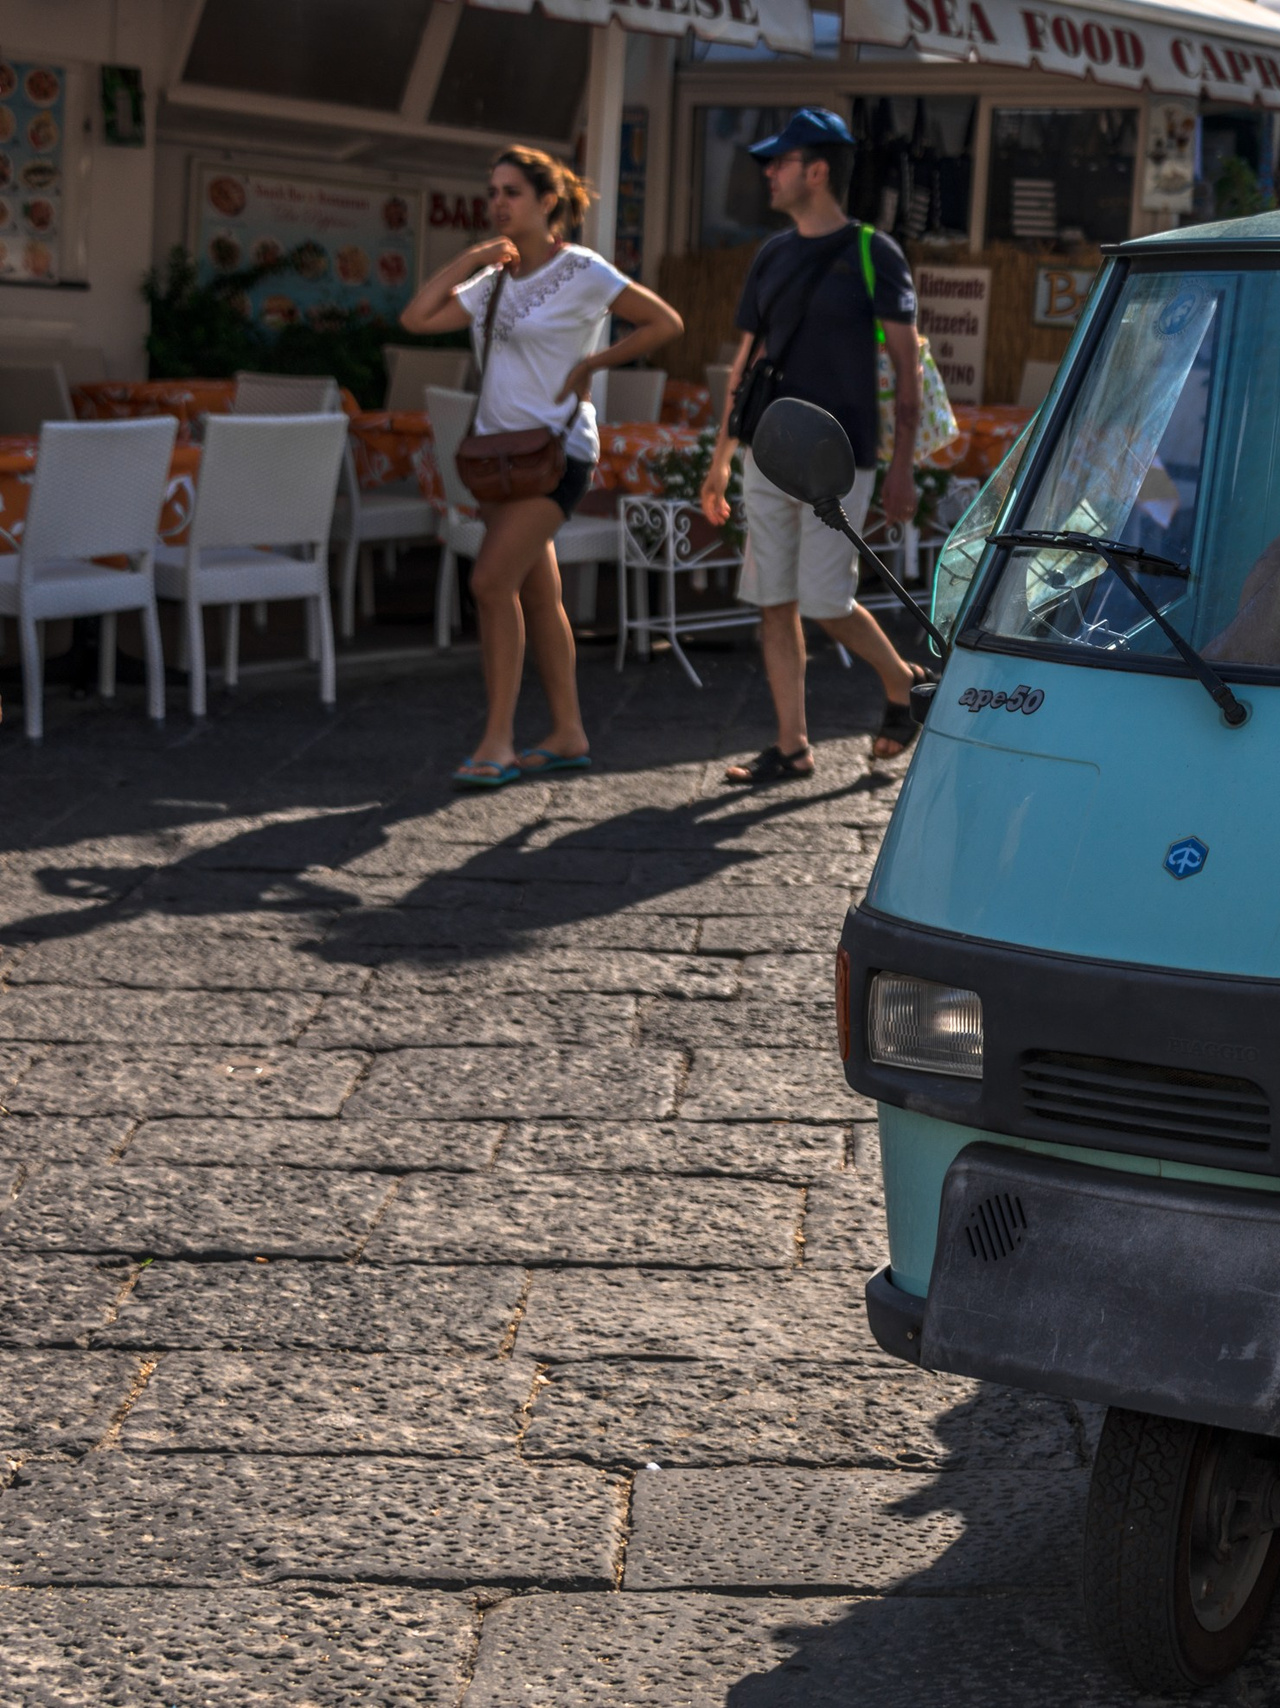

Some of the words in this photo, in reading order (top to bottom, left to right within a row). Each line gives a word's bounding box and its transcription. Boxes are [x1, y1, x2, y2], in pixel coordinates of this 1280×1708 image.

[907, 0, 999, 45] SEA
[1020, 8, 1146, 71] FOOD
[429, 192, 492, 229] BAR
[919, 273, 985, 300] Ristorante
[919, 308, 979, 336] Pizzeria
[1166, 1036, 1261, 1063] PIAGGIO
